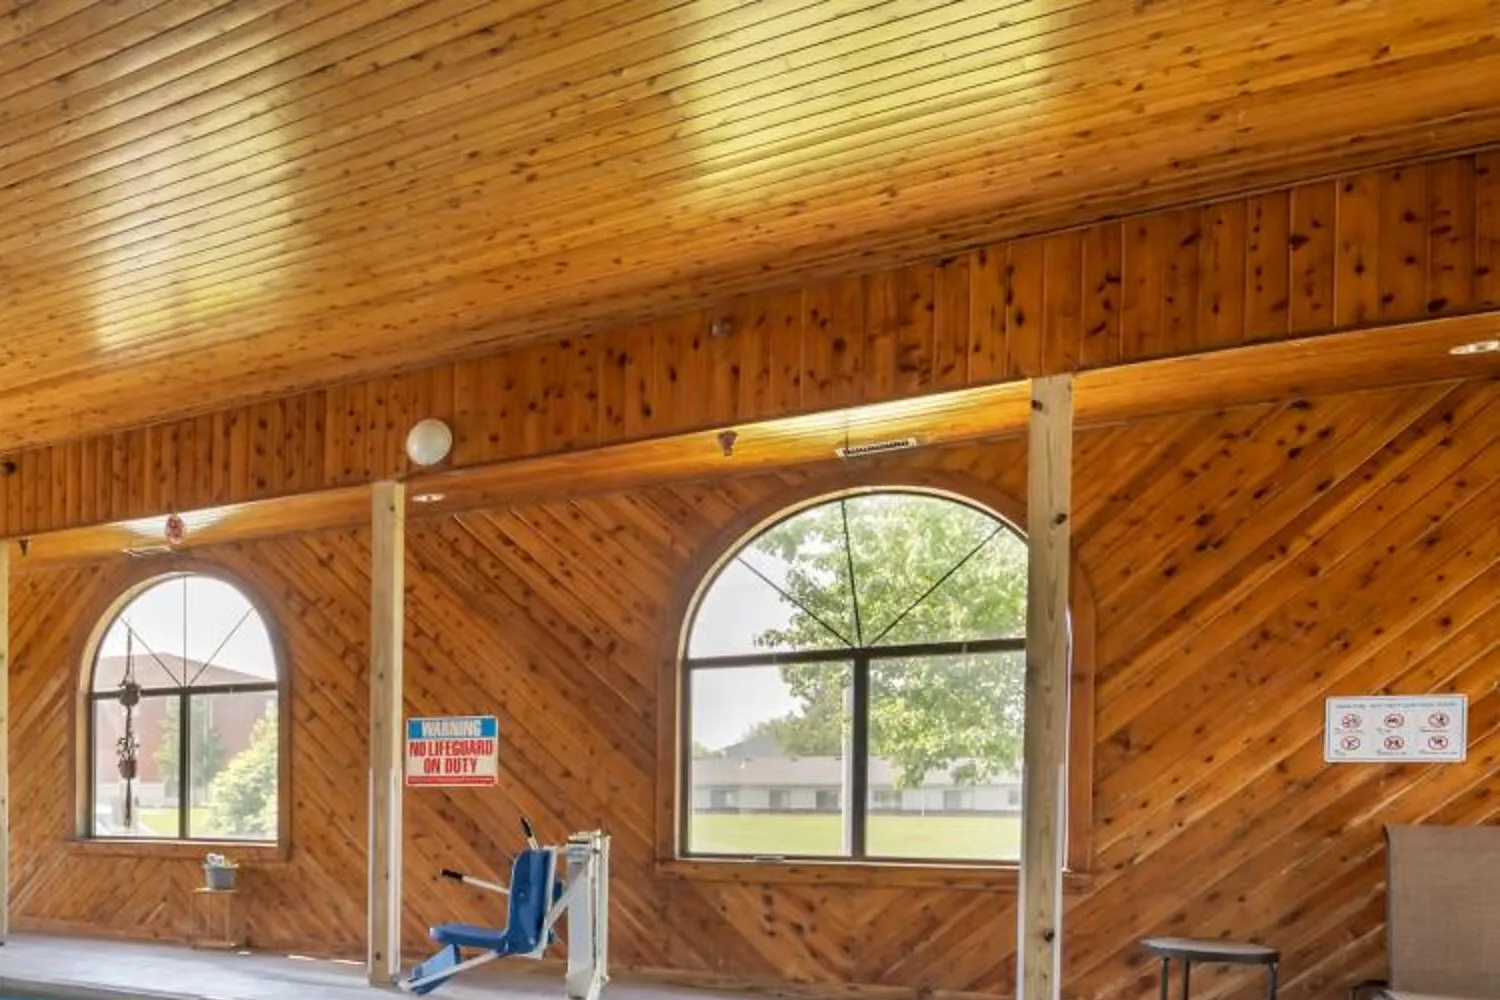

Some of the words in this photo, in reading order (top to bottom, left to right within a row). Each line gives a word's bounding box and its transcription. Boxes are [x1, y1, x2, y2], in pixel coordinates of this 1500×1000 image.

[421, 719, 482, 737] WARNING
[409, 741, 426, 757] NO
[428, 740, 493, 756] LIFEGUARD
[424, 758, 441, 773] ON
[445, 758, 477, 773] DUTY
